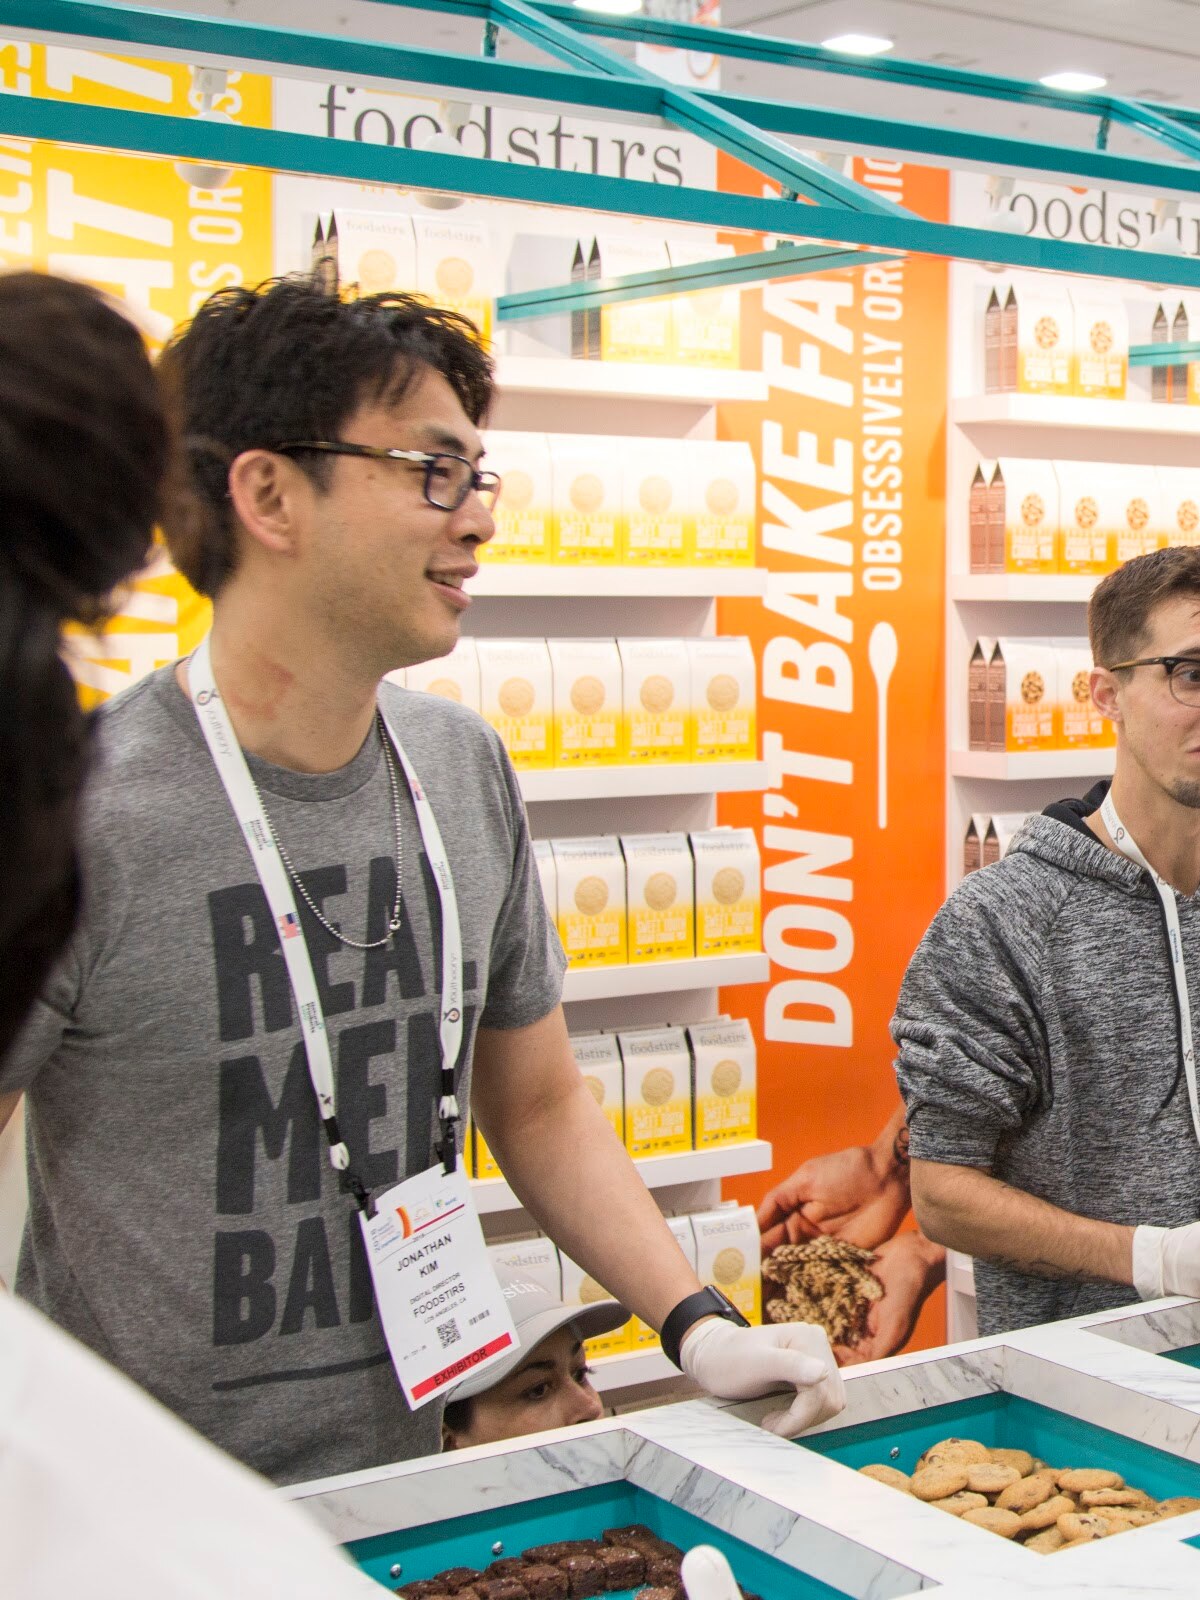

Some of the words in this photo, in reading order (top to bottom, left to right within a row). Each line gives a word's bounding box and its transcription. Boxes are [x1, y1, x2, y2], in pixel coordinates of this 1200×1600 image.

[862, 332, 904, 591] OBSESSIVELY
[762, 419, 854, 714] BAKE
[763, 731, 855, 1049] DON'T
[208, 852, 477, 1041] REAL
[629, 1040, 681, 1057] foodstirs
[702, 1220, 751, 1237] foodstirs
[397, 1233, 453, 1272] JONATHAN
[419, 1260, 439, 1279] KIM
[409, 1286, 432, 1305] DIGITAL
[432, 1272, 461, 1294] DIRECTOR
[413, 1282, 466, 1319] FOODSTIRS
[433, 1348, 488, 1387] EXHIBITOR
